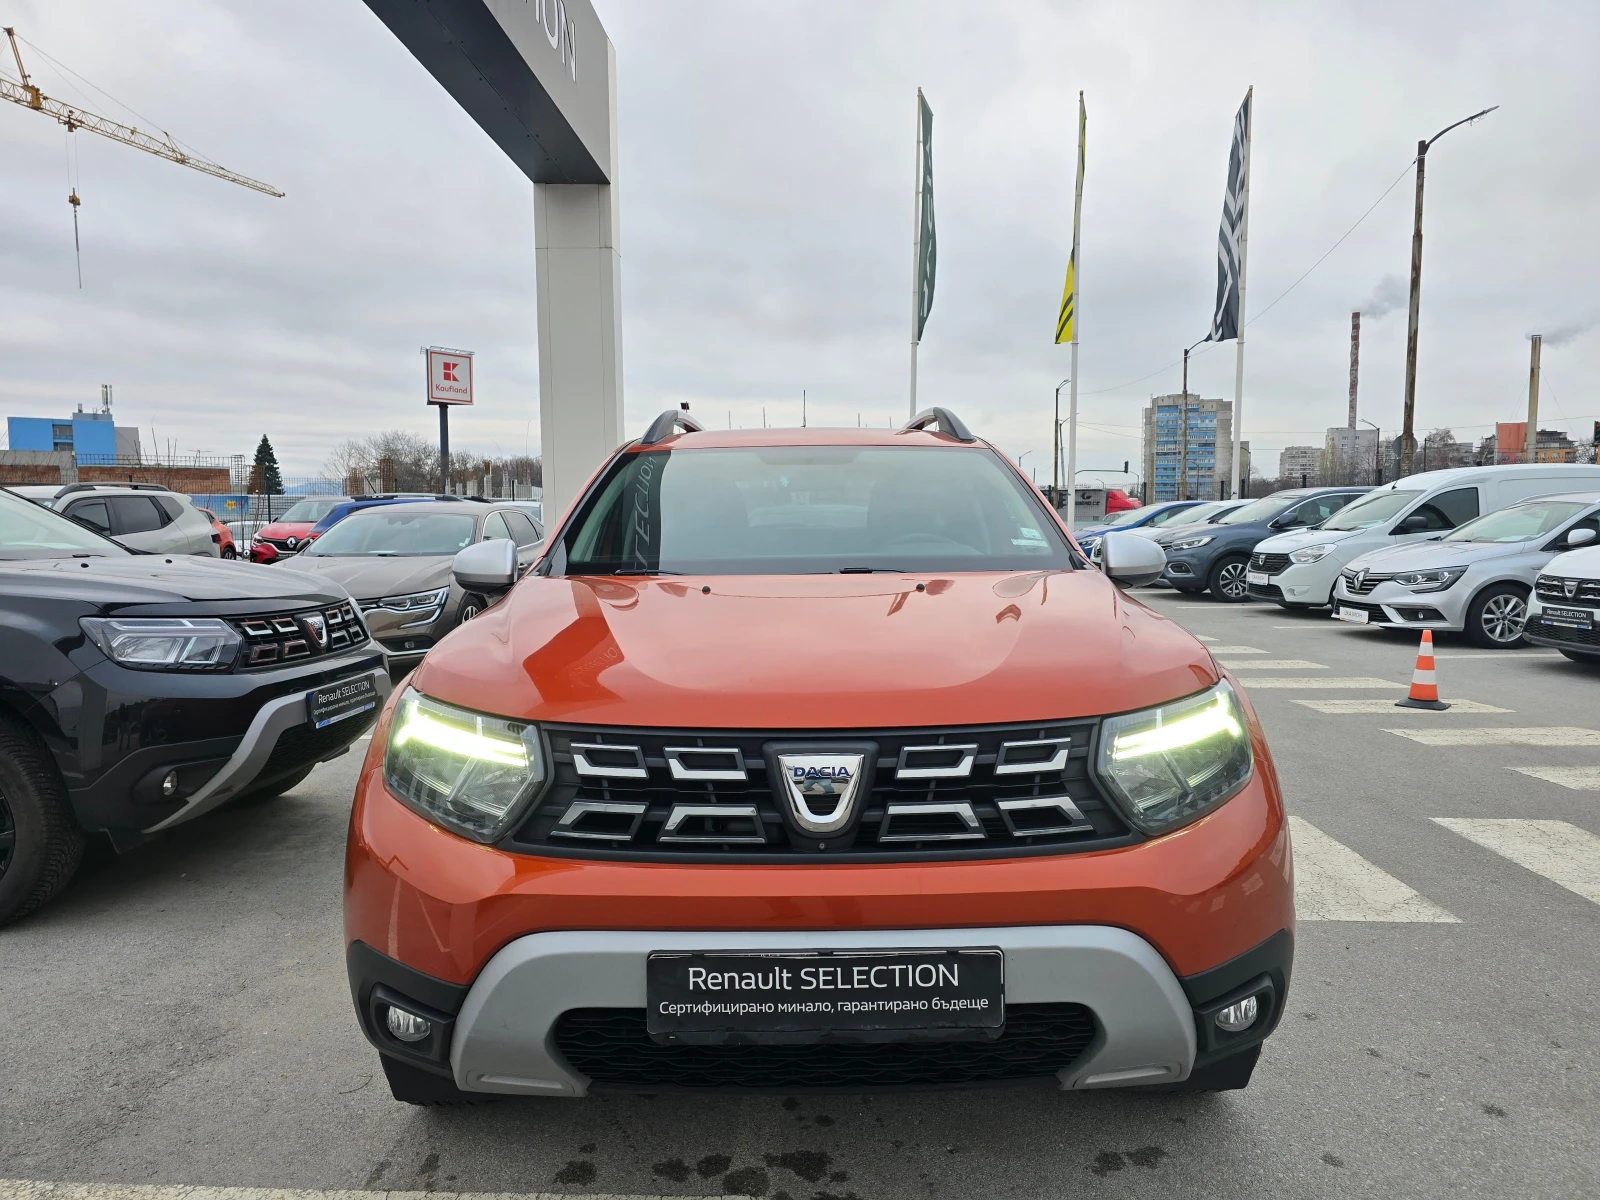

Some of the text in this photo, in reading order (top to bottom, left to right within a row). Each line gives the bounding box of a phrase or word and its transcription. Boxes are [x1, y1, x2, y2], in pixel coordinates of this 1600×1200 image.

[435, 384, 468, 394] Kaufland
[318, 689, 342, 704] Renault
[341, 680, 370, 697] SELECTION
[793, 766, 851, 778] DACIA
[688, 963, 959, 990] Renault SELECTION
[659, 997, 989, 1017] Сертифицирано минало, гарантирано бъдеще
